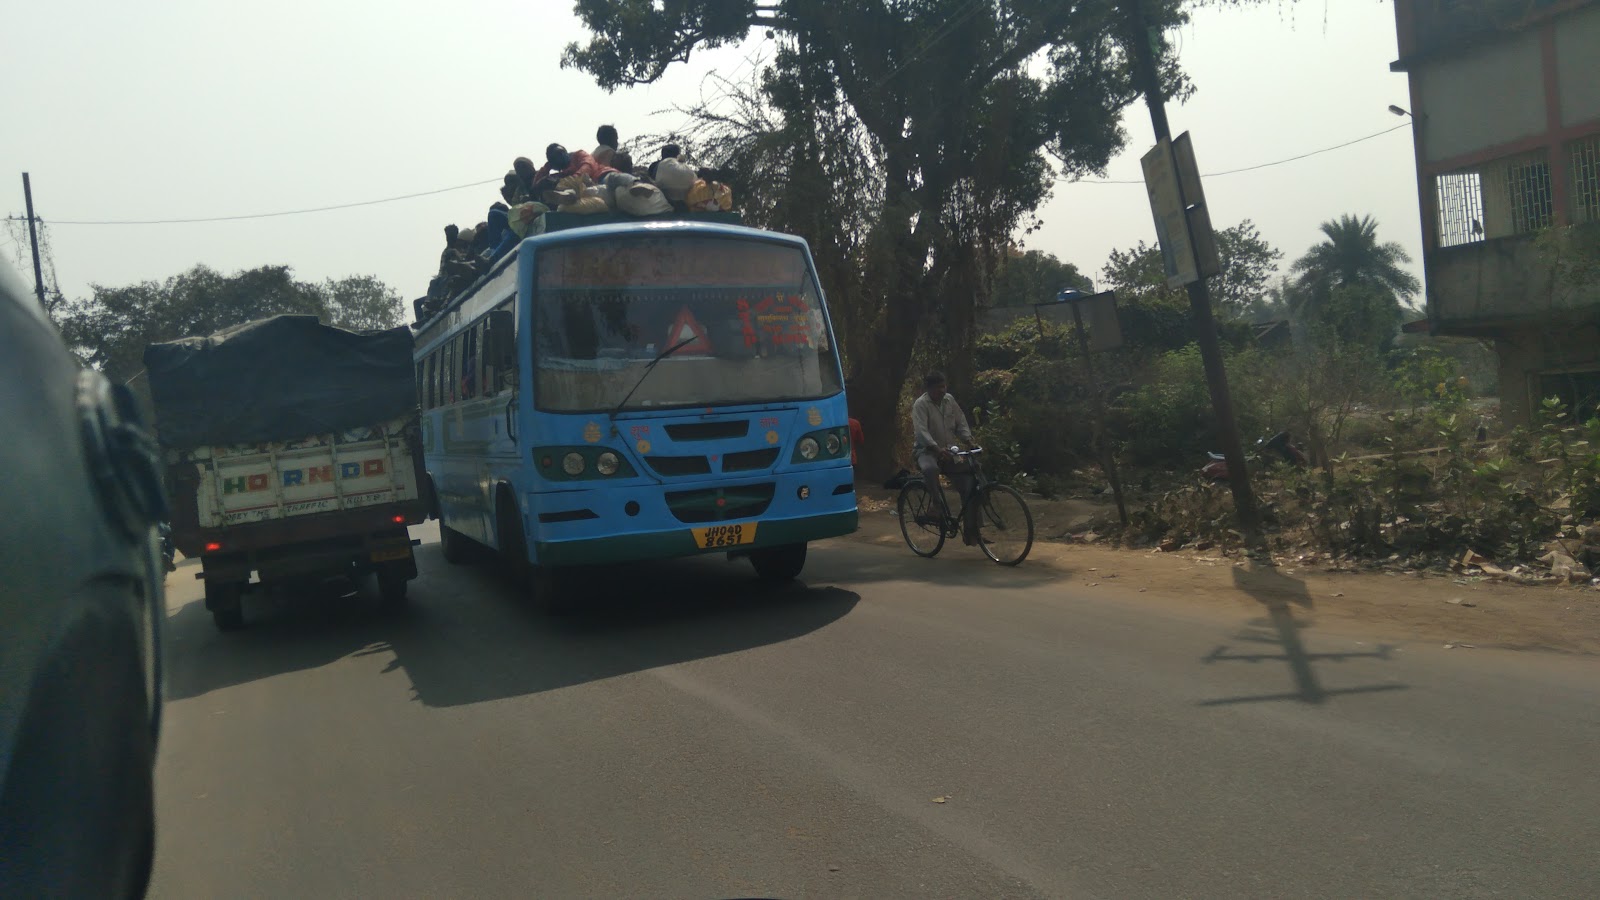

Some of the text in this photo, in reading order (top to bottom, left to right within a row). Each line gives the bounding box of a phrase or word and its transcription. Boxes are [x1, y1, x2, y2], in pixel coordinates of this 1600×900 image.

[226, 511, 247, 521] OBEY
[286, 501, 328, 513] TRAFFIC
[705, 524, 742, 538] JH04D
[705, 534, 742, 546] 8651
